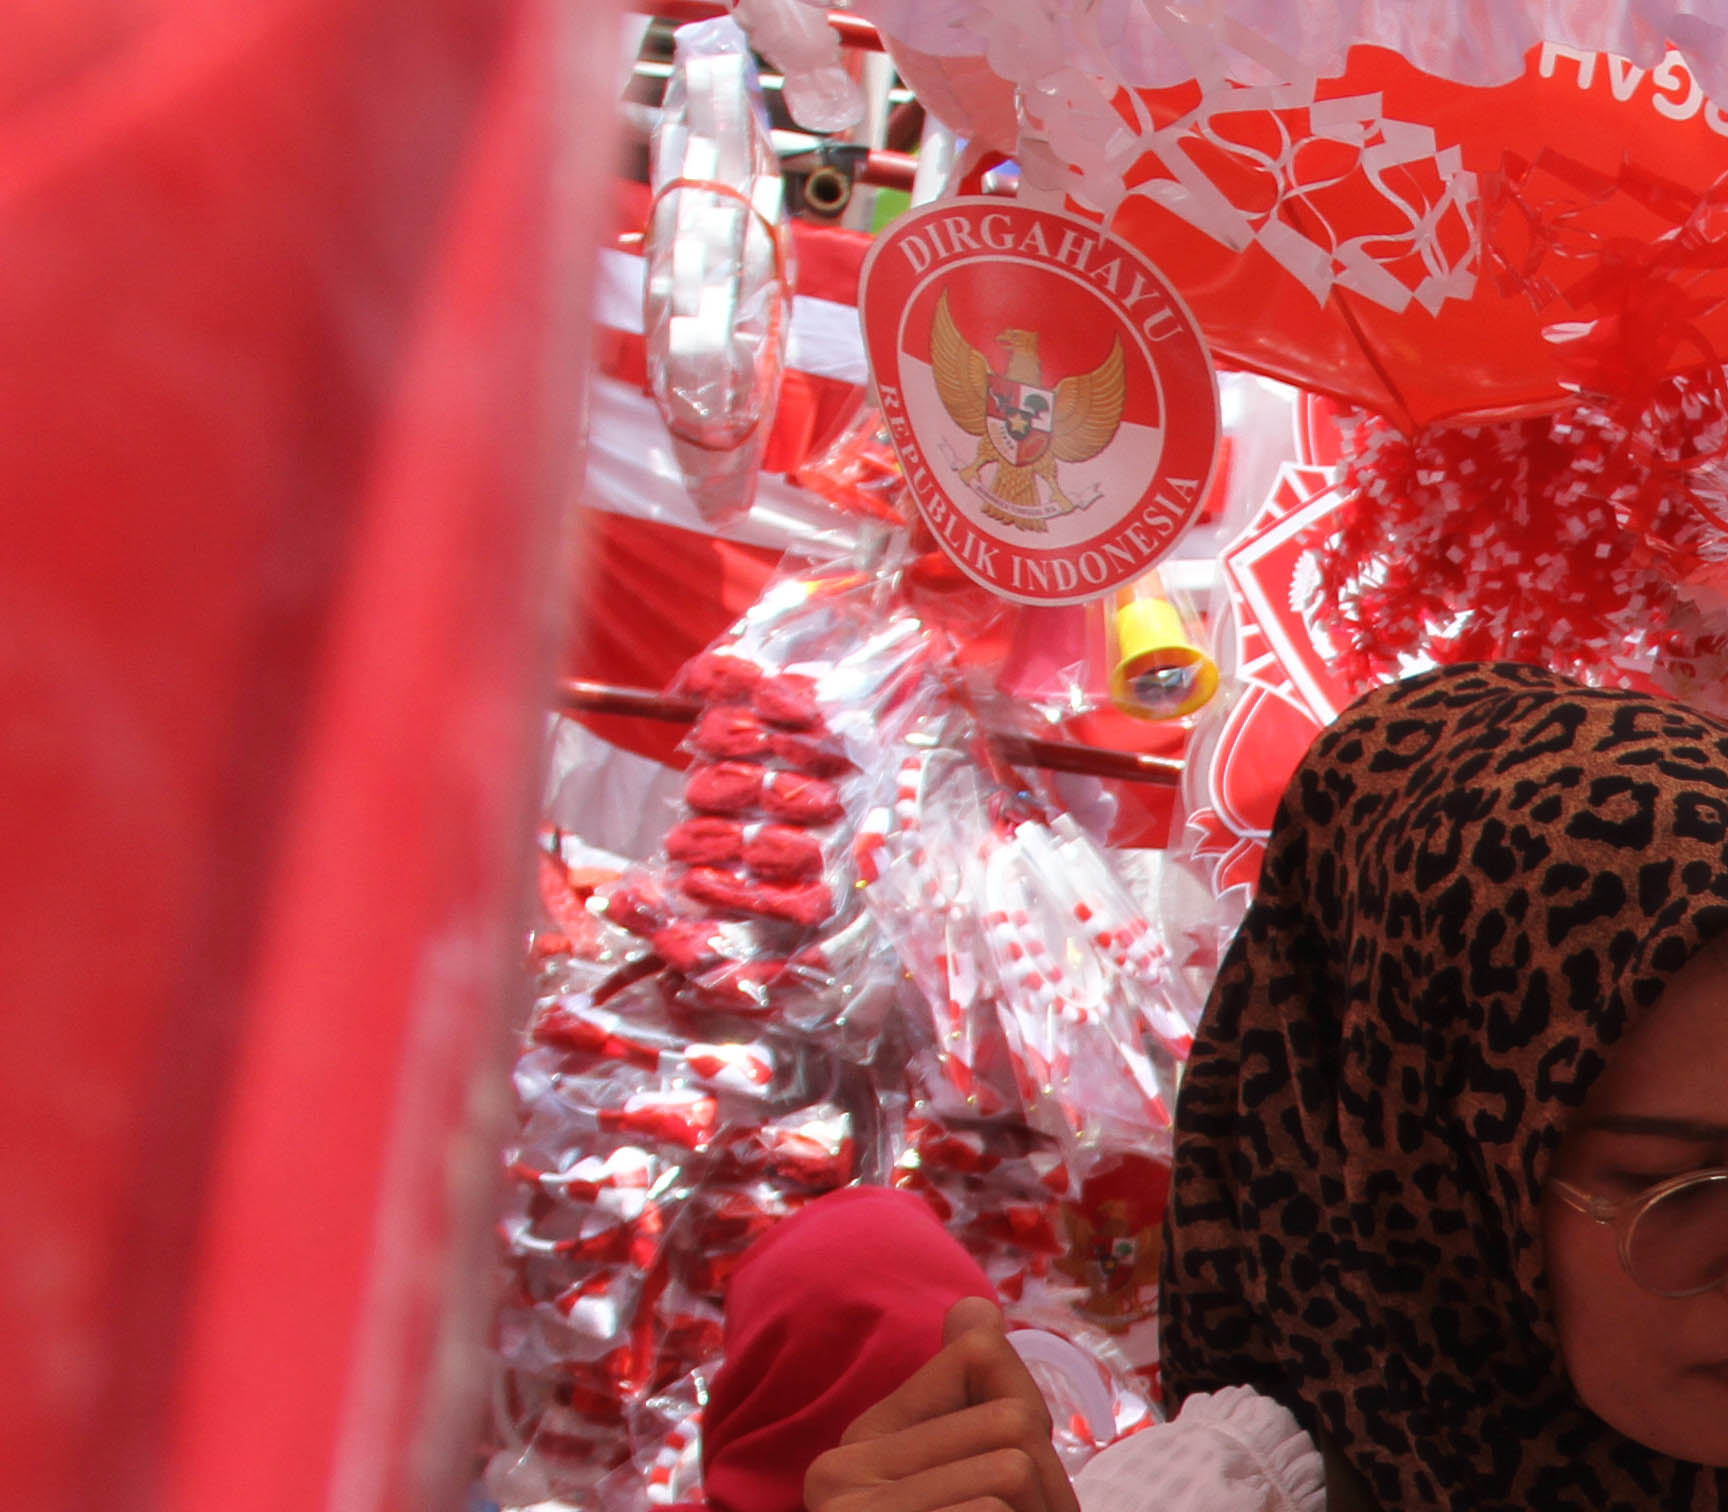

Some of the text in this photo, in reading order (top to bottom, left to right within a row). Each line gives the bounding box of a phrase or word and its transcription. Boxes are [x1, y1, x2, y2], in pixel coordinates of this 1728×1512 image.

[897, 213, 1184, 342] DIRGAHAYU
[880, 385, 1200, 592] REPUBLIK INDONESIA
